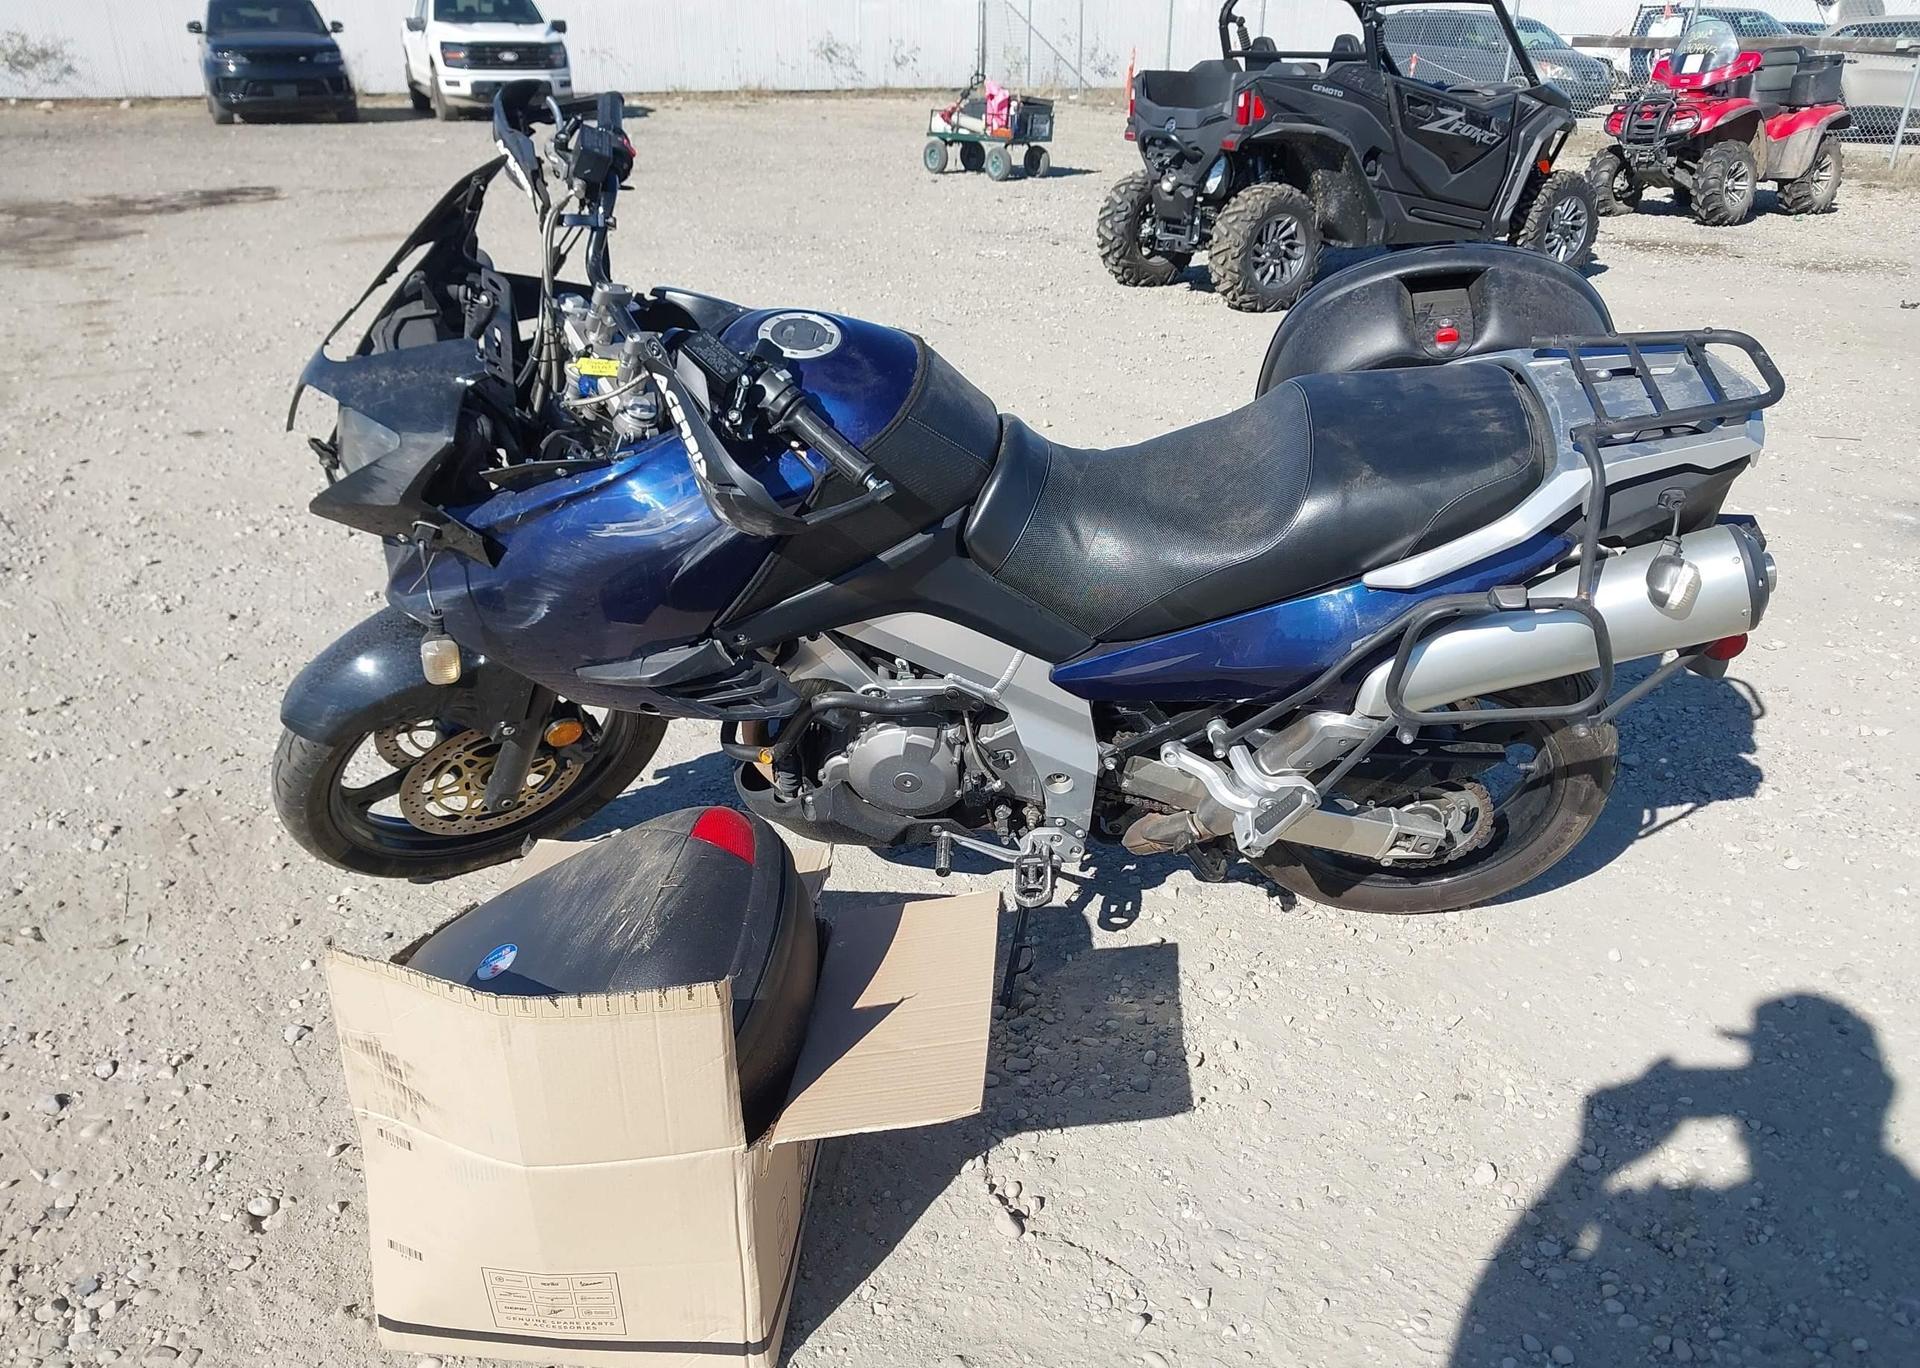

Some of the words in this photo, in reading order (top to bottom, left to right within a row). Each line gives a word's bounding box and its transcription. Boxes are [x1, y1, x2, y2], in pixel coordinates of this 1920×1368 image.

[1311, 83, 1344, 98] CFMOTO
[652, 372, 707, 479] ACERBIS
[505, 1316, 547, 1324] GENUINE
[533, 1322, 598, 1330] ACCESSORIES
